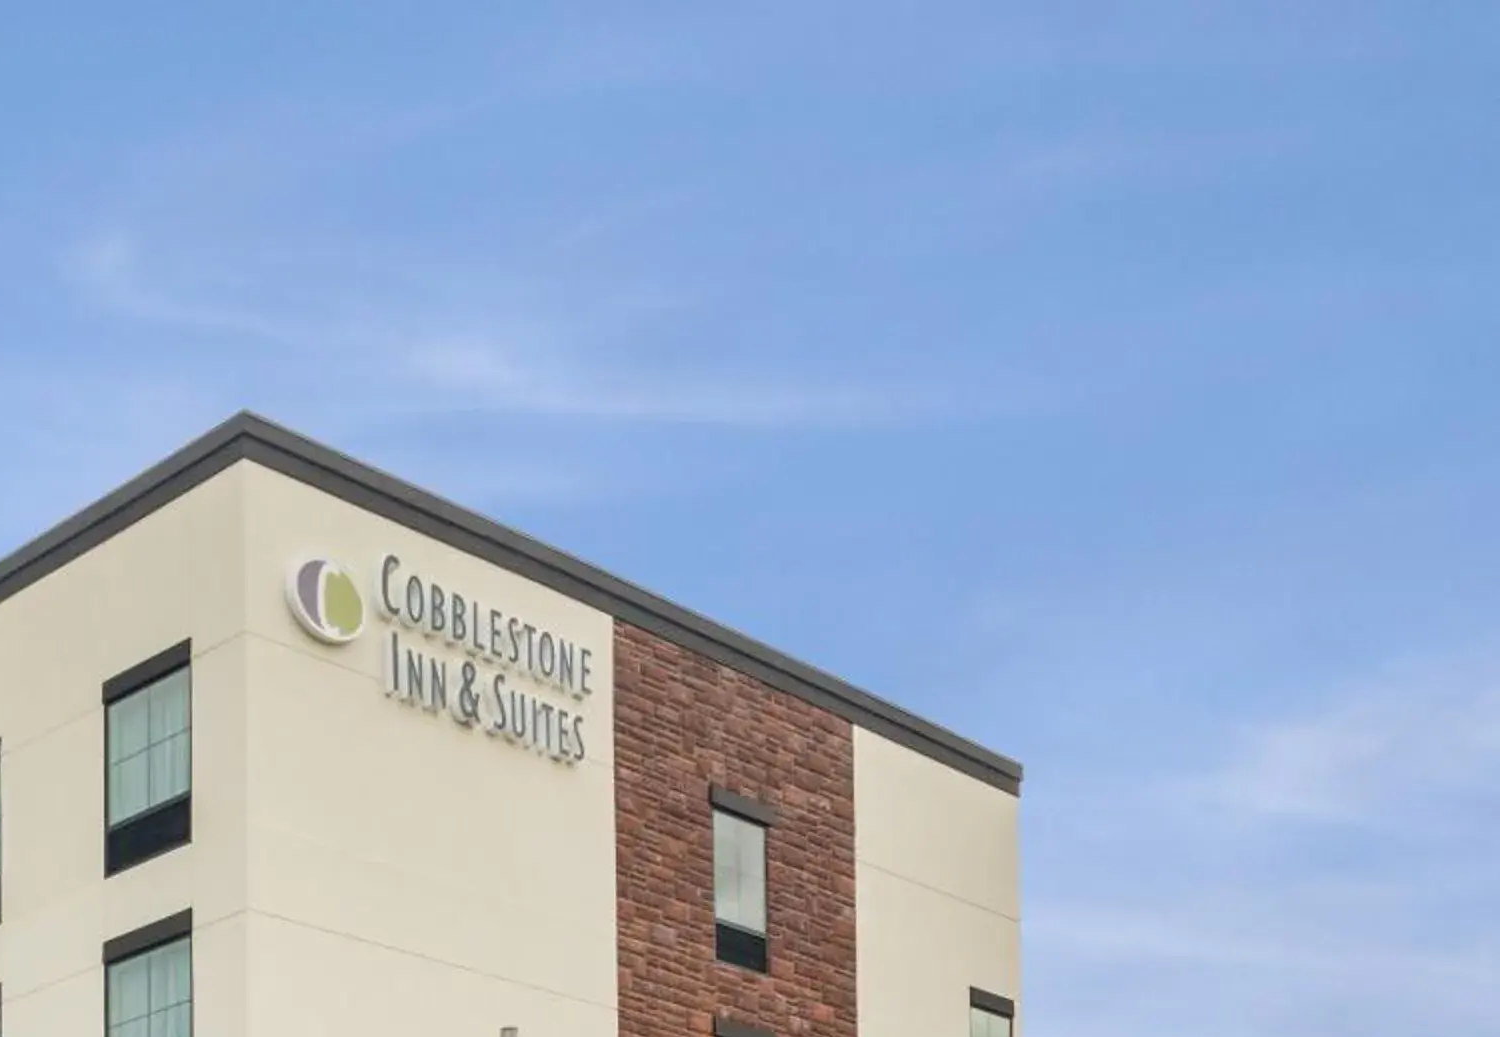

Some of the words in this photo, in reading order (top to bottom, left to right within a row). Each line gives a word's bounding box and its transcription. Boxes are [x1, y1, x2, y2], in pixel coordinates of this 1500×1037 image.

[381, 553, 593, 695] COBBLESTONE
[387, 630, 448, 710] INN
[458, 659, 481, 724] &
[493, 673, 586, 762] SUITES
